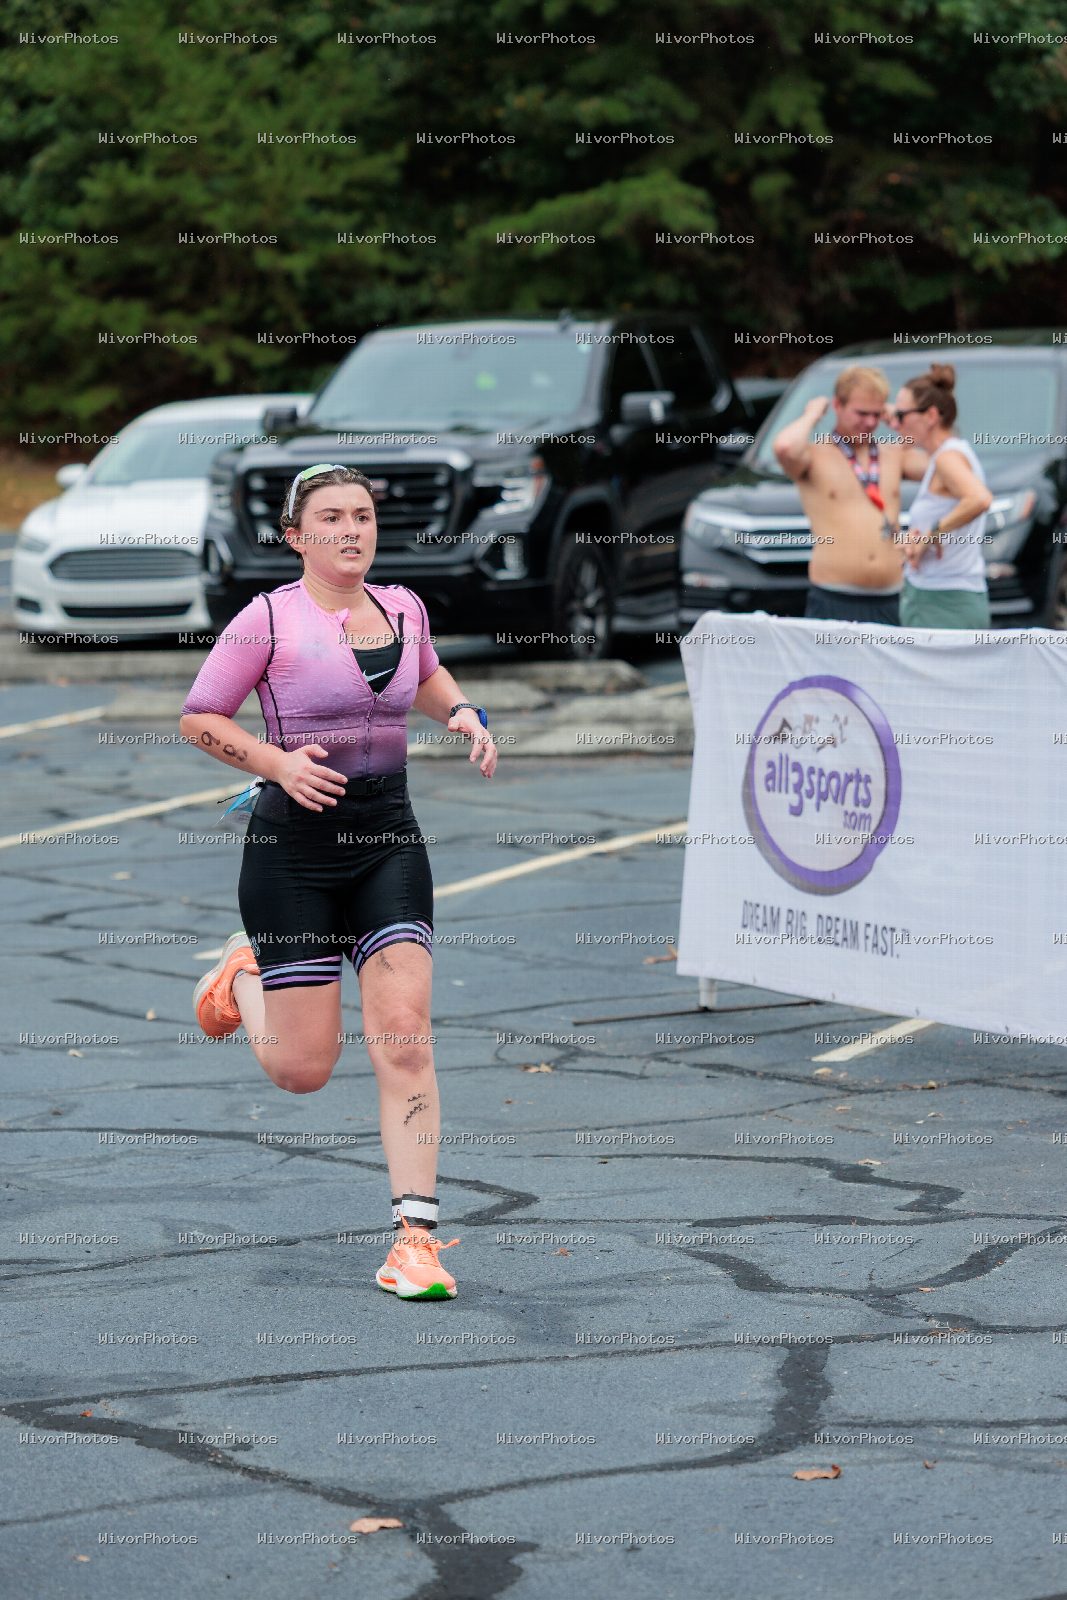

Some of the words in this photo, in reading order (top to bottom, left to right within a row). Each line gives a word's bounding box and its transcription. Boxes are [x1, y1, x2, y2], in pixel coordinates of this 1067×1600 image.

[764, 752, 873, 817] all3sports
[741, 899, 781, 935] DREAM
[815, 913, 860, 951] DREAM
